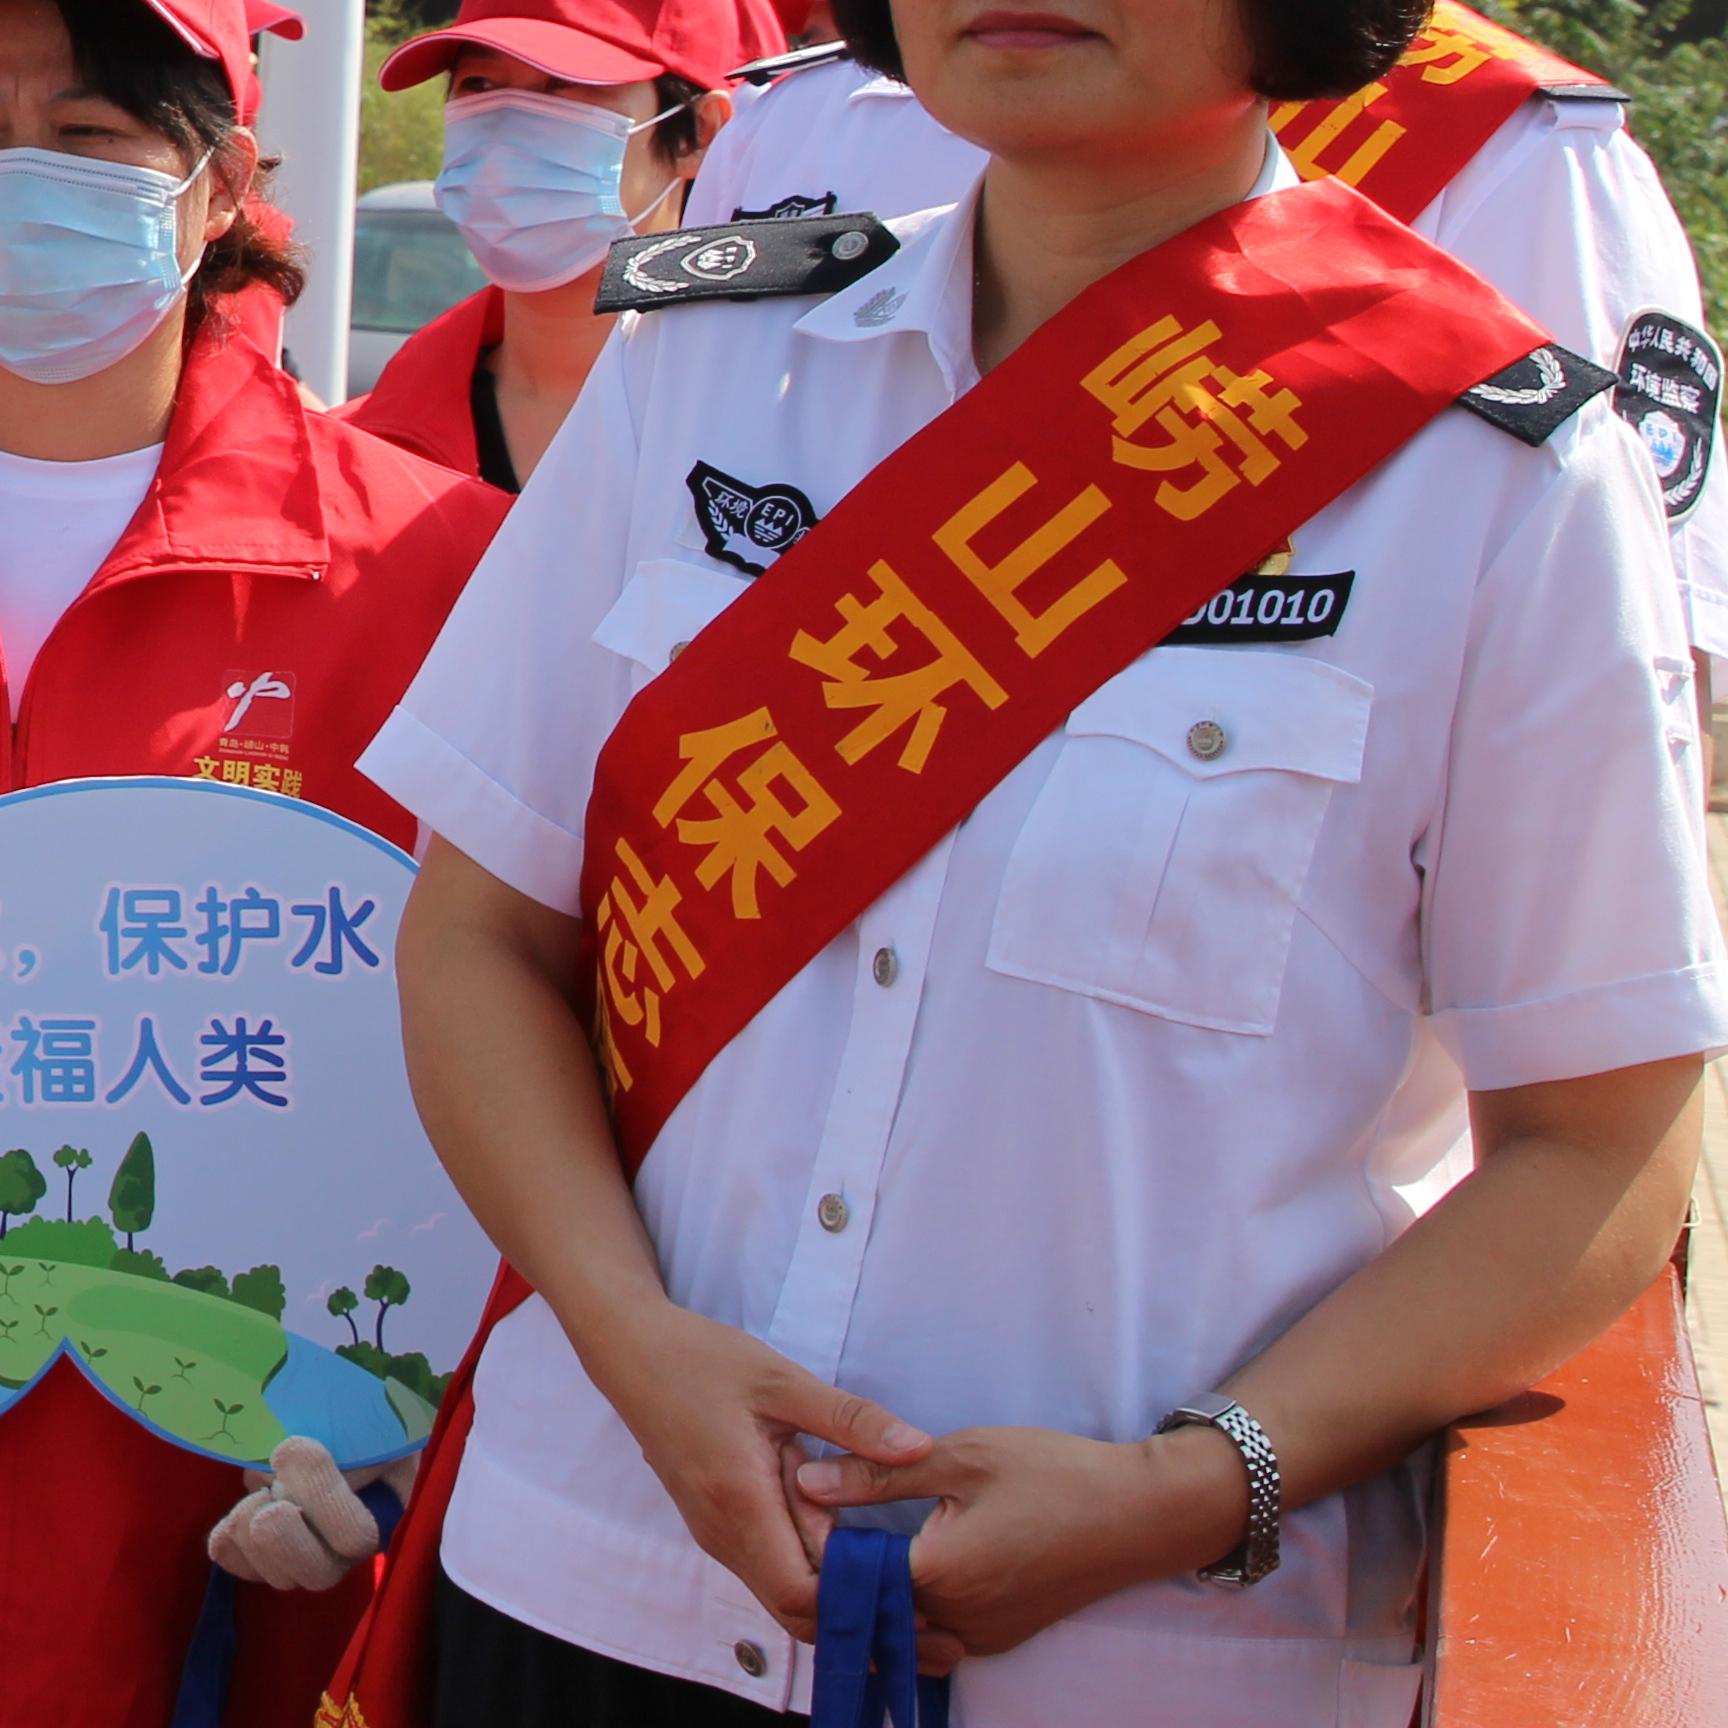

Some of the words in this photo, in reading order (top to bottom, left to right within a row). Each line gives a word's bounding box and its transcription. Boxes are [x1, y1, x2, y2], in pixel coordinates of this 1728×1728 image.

[1628, 325, 1720, 391] 中华人民共和国
[714, 491, 750, 519] 环境
[760, 503, 794, 526] EPI
[192, 756, 303, 798] 文明实践
